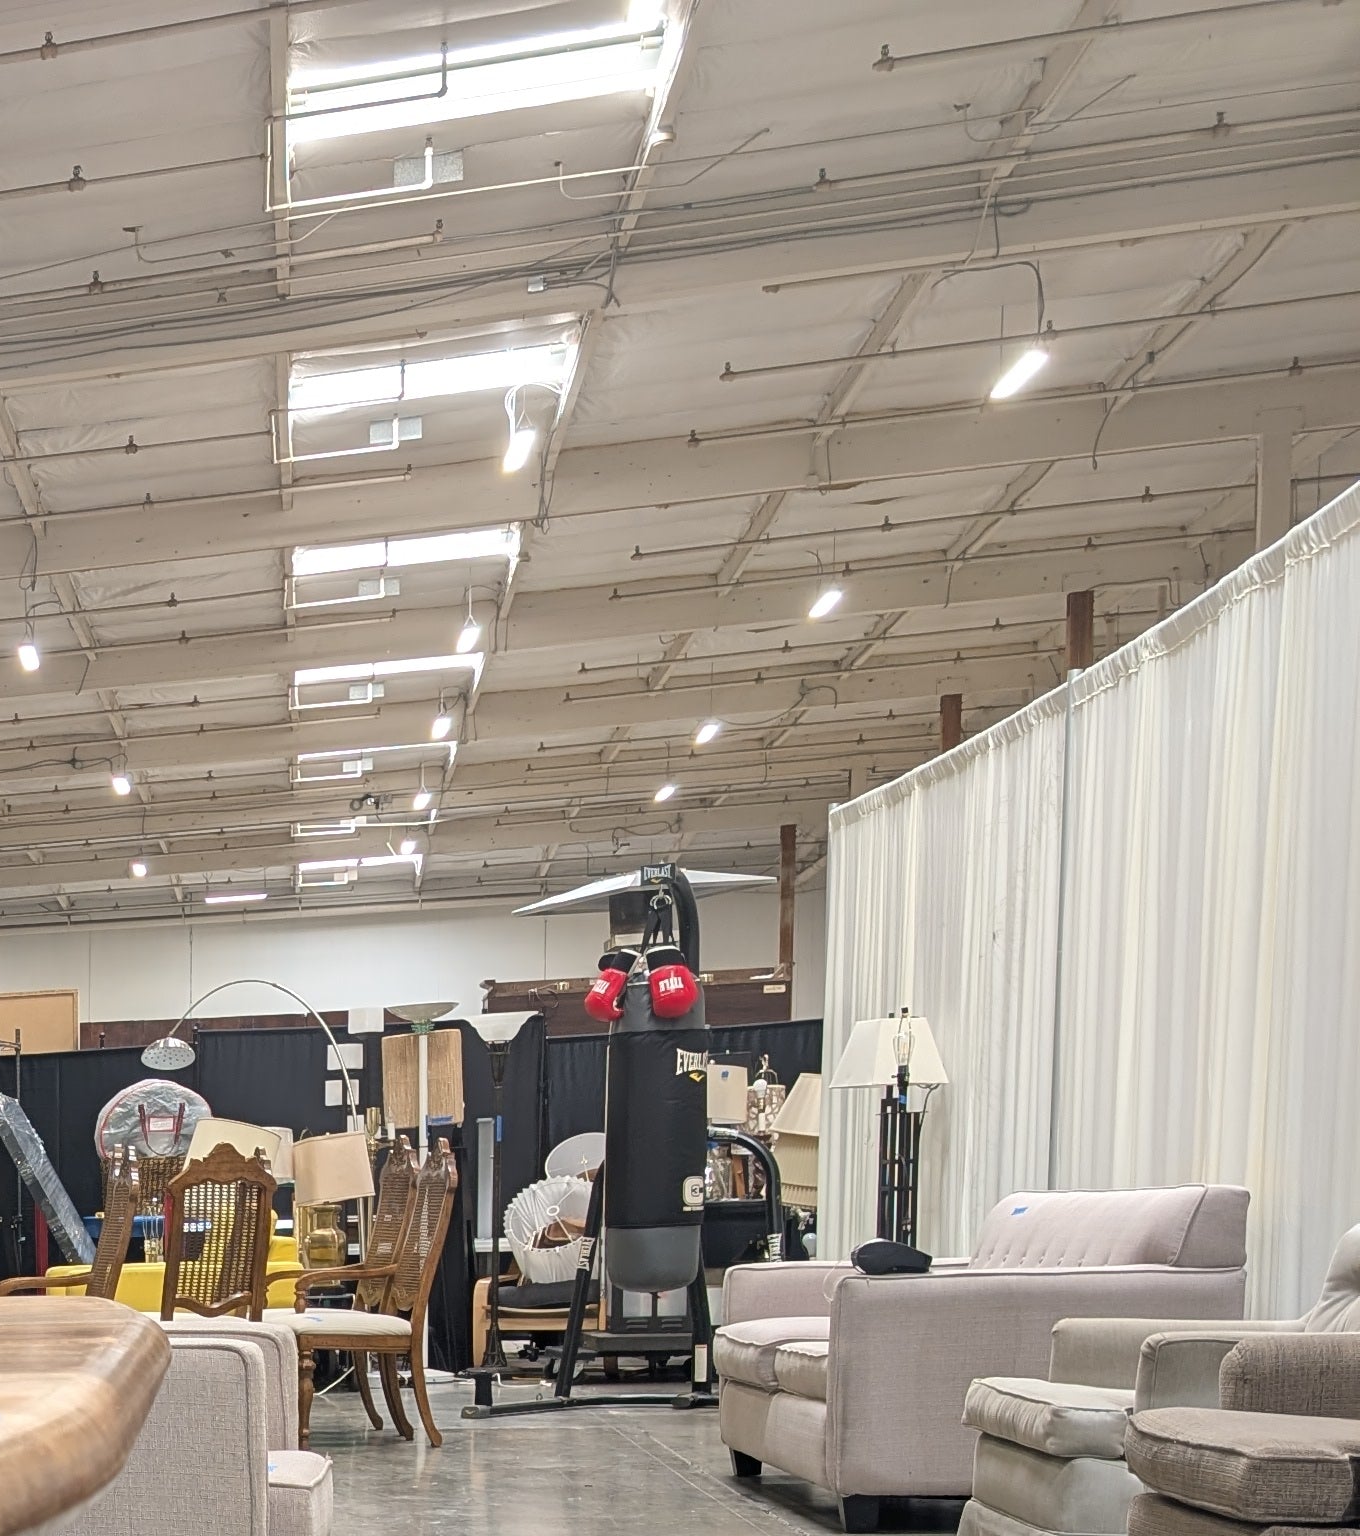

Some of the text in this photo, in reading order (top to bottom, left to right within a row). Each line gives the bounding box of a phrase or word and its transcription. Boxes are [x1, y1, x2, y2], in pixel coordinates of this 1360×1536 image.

[643, 864, 672, 881] EVERLAST
[658, 976, 685, 993] TITLE
[576, 1236, 596, 1272] EVERLAST
